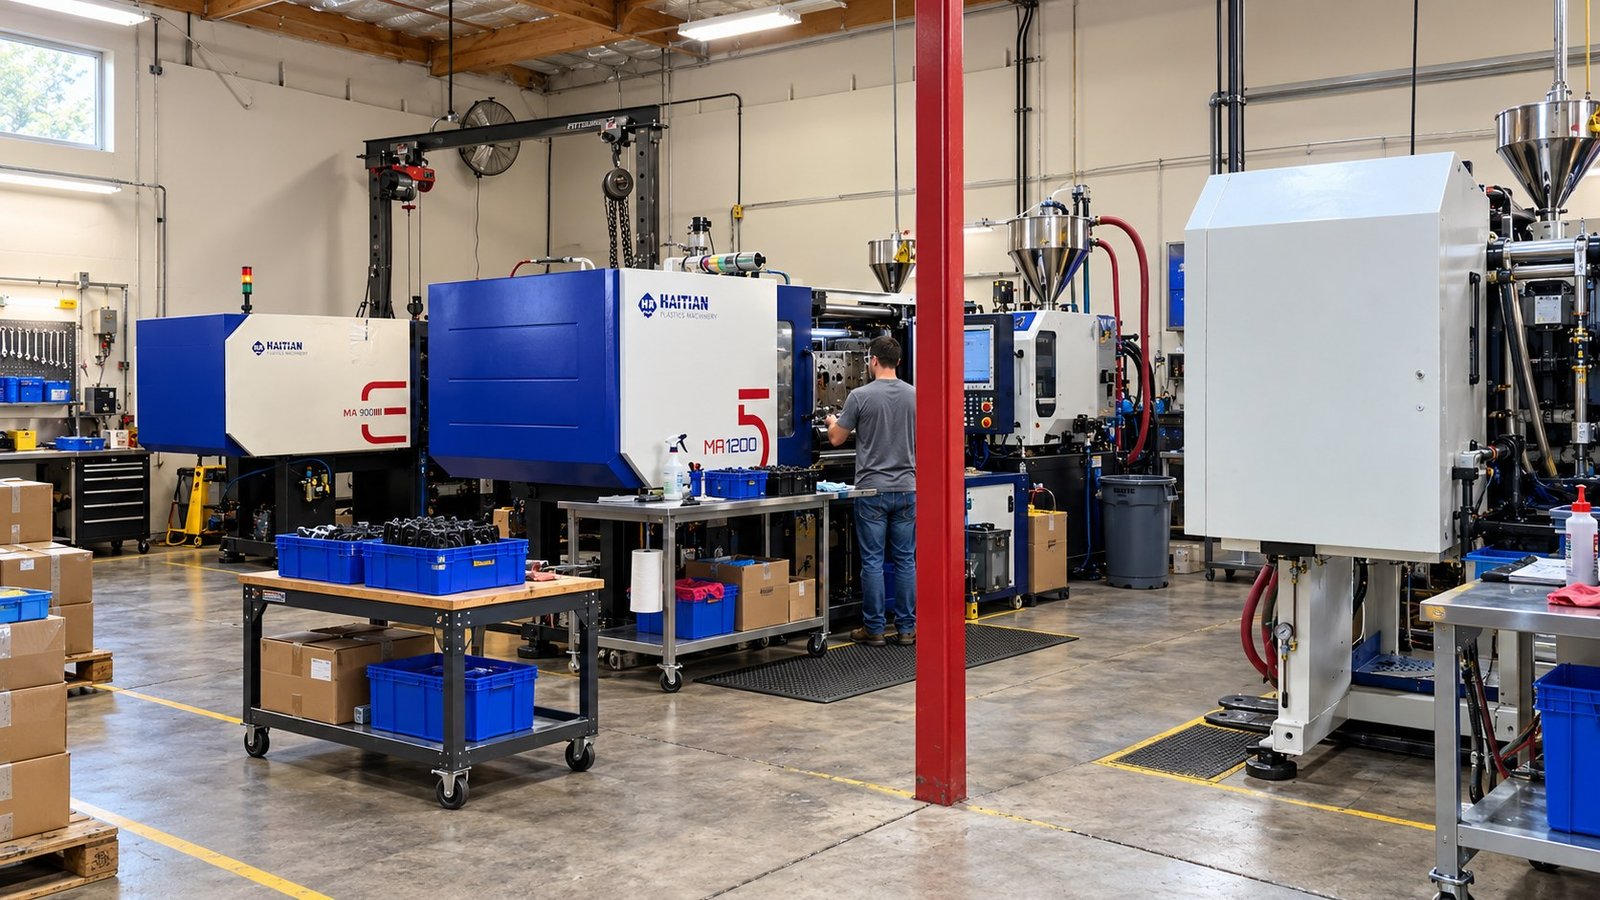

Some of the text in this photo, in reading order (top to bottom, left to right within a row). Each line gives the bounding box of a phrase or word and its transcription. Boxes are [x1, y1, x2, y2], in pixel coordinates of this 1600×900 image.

[660, 293, 709, 311] HAITIAN
[266, 341, 303, 350] HAITIAN
[343, 409, 358, 417] MA
